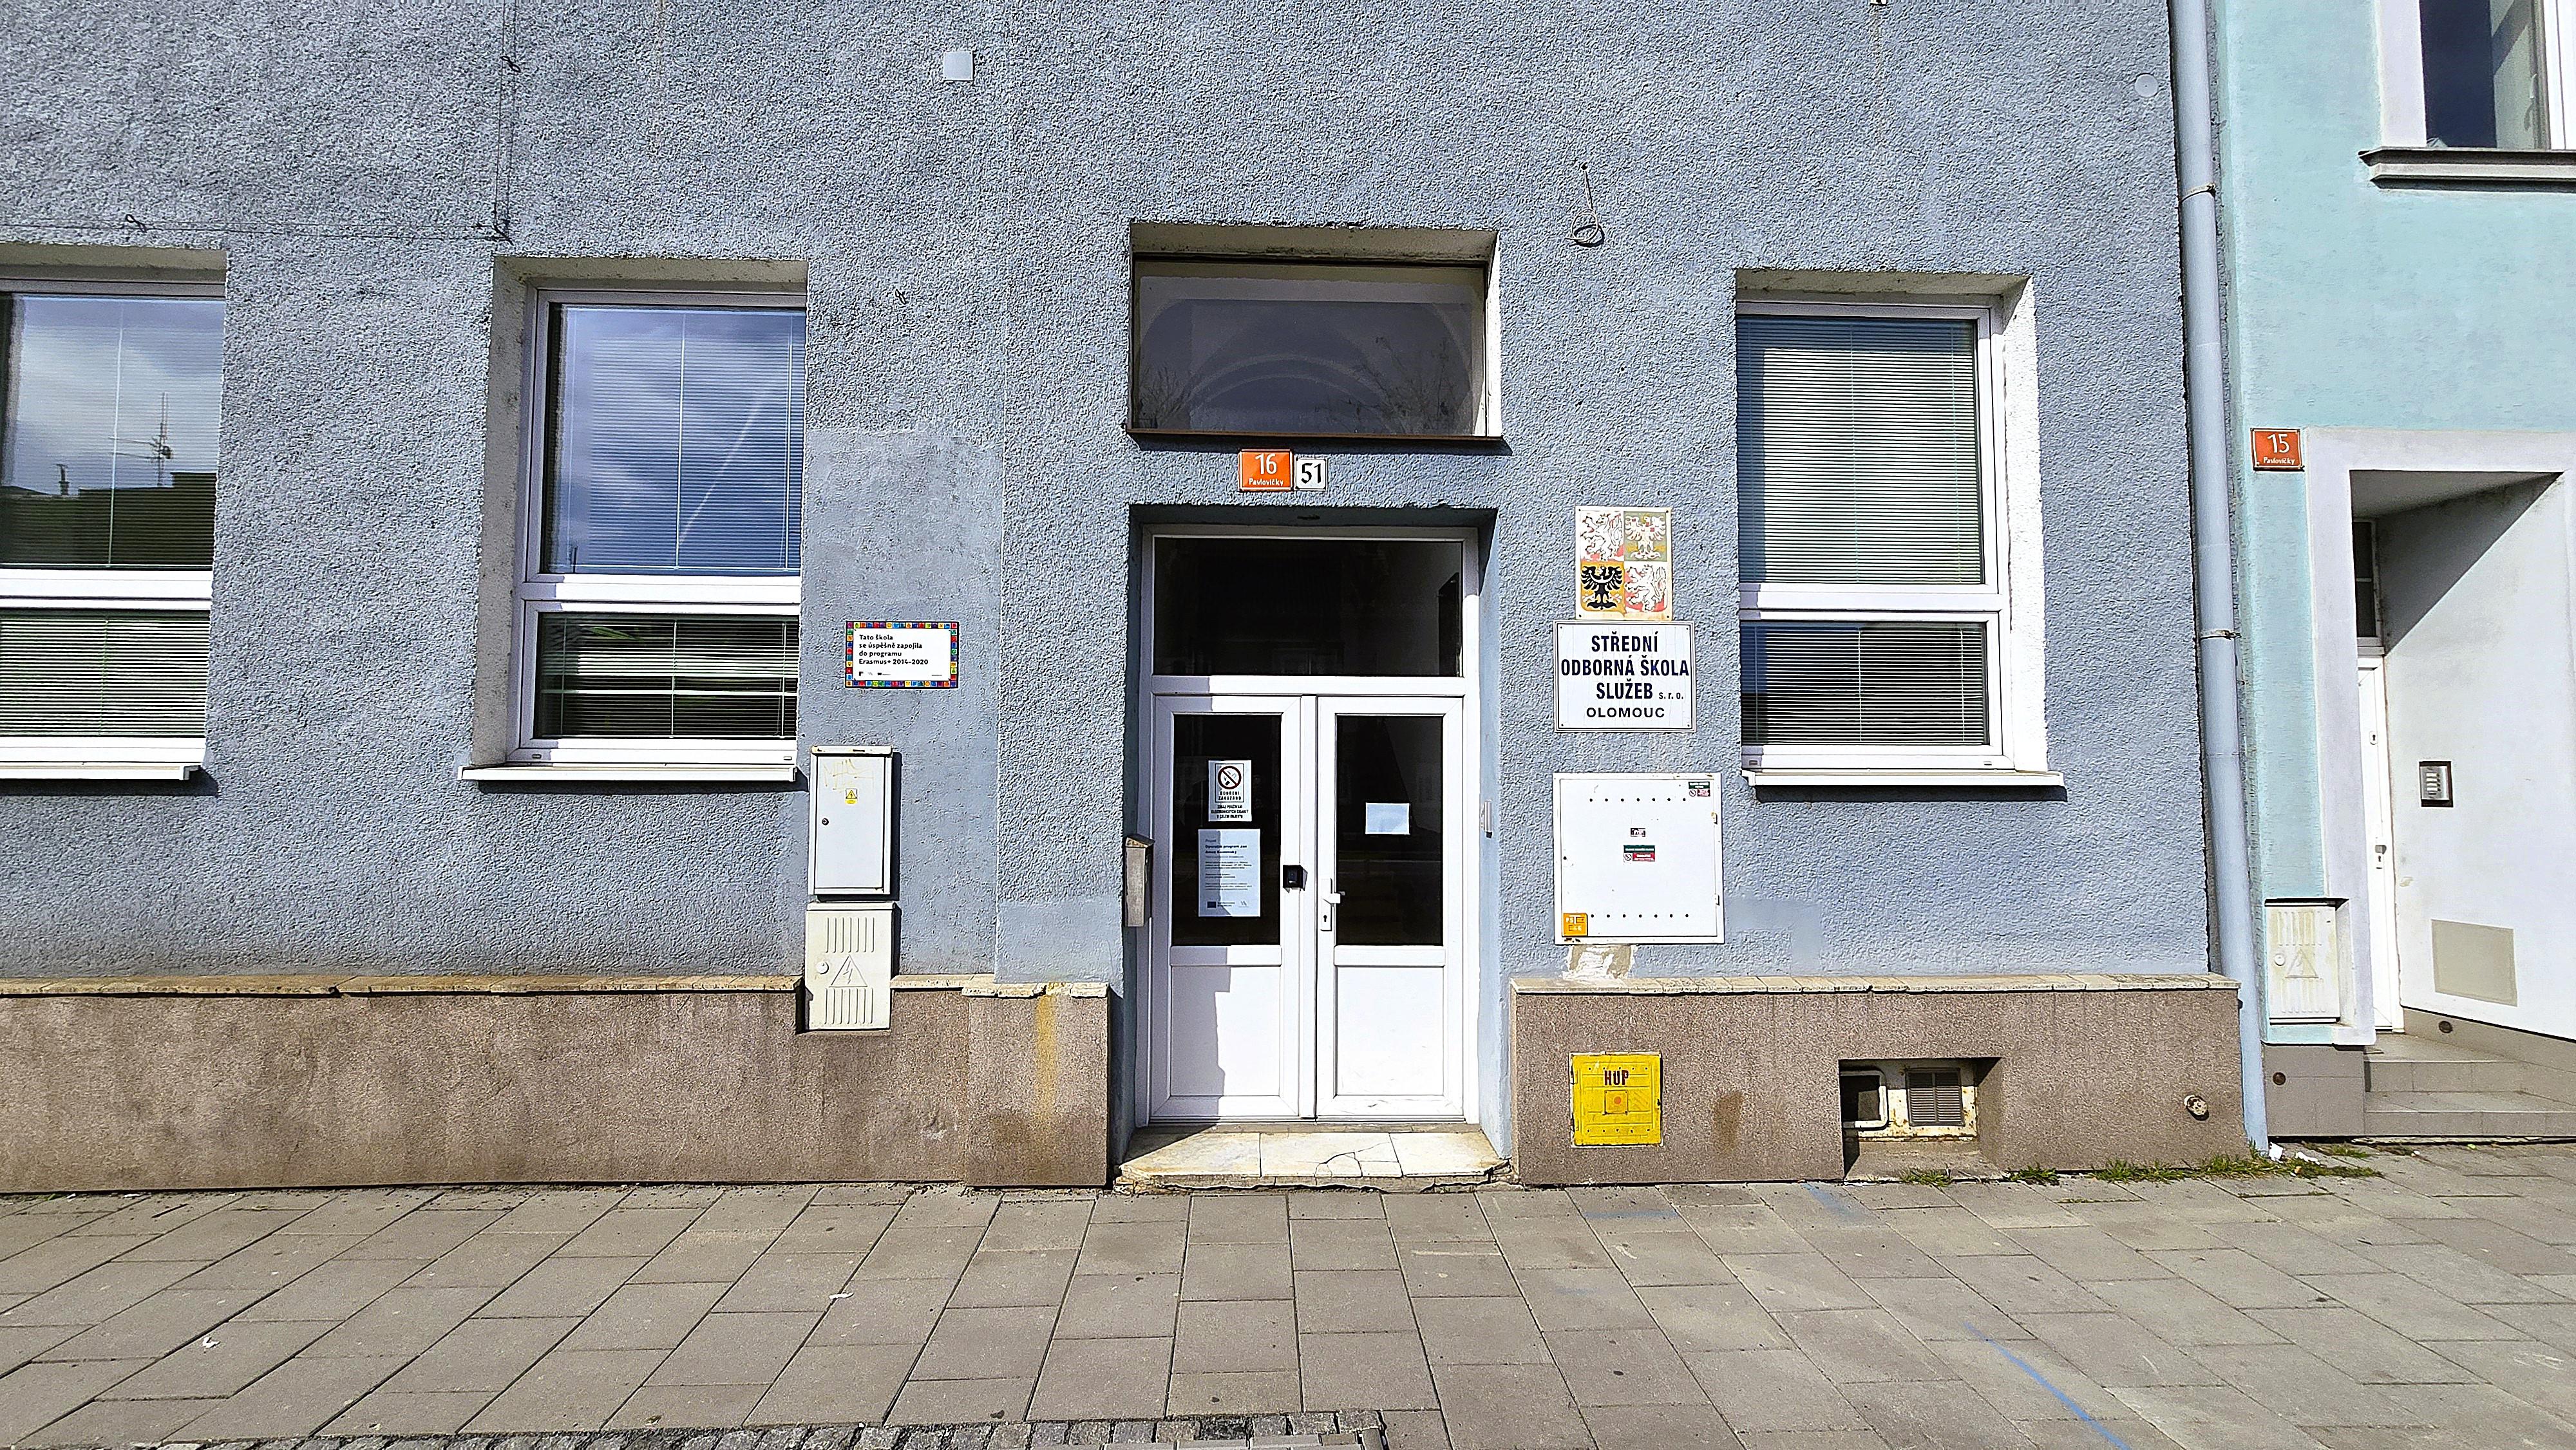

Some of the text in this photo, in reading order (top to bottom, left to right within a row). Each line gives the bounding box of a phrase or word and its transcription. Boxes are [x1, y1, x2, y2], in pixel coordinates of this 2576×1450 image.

[2267, 433, 2289, 453] 15
[1255, 453, 1277, 475] 16
[2263, 457, 2295, 465] Pavlovičky
[1249, 478, 1283, 486] Pavlovičky
[1301, 462, 1321, 484] 51
[1591, 631, 1658, 652] STŘEDNÍ
[1561, 655, 1689, 676] ODBORNÁ ŠKOLA
[1596, 678, 1653, 699] SLUŽEB
[1586, 707, 1665, 718] OLOMOUC
[1604, 1070, 1629, 1086] HUP
